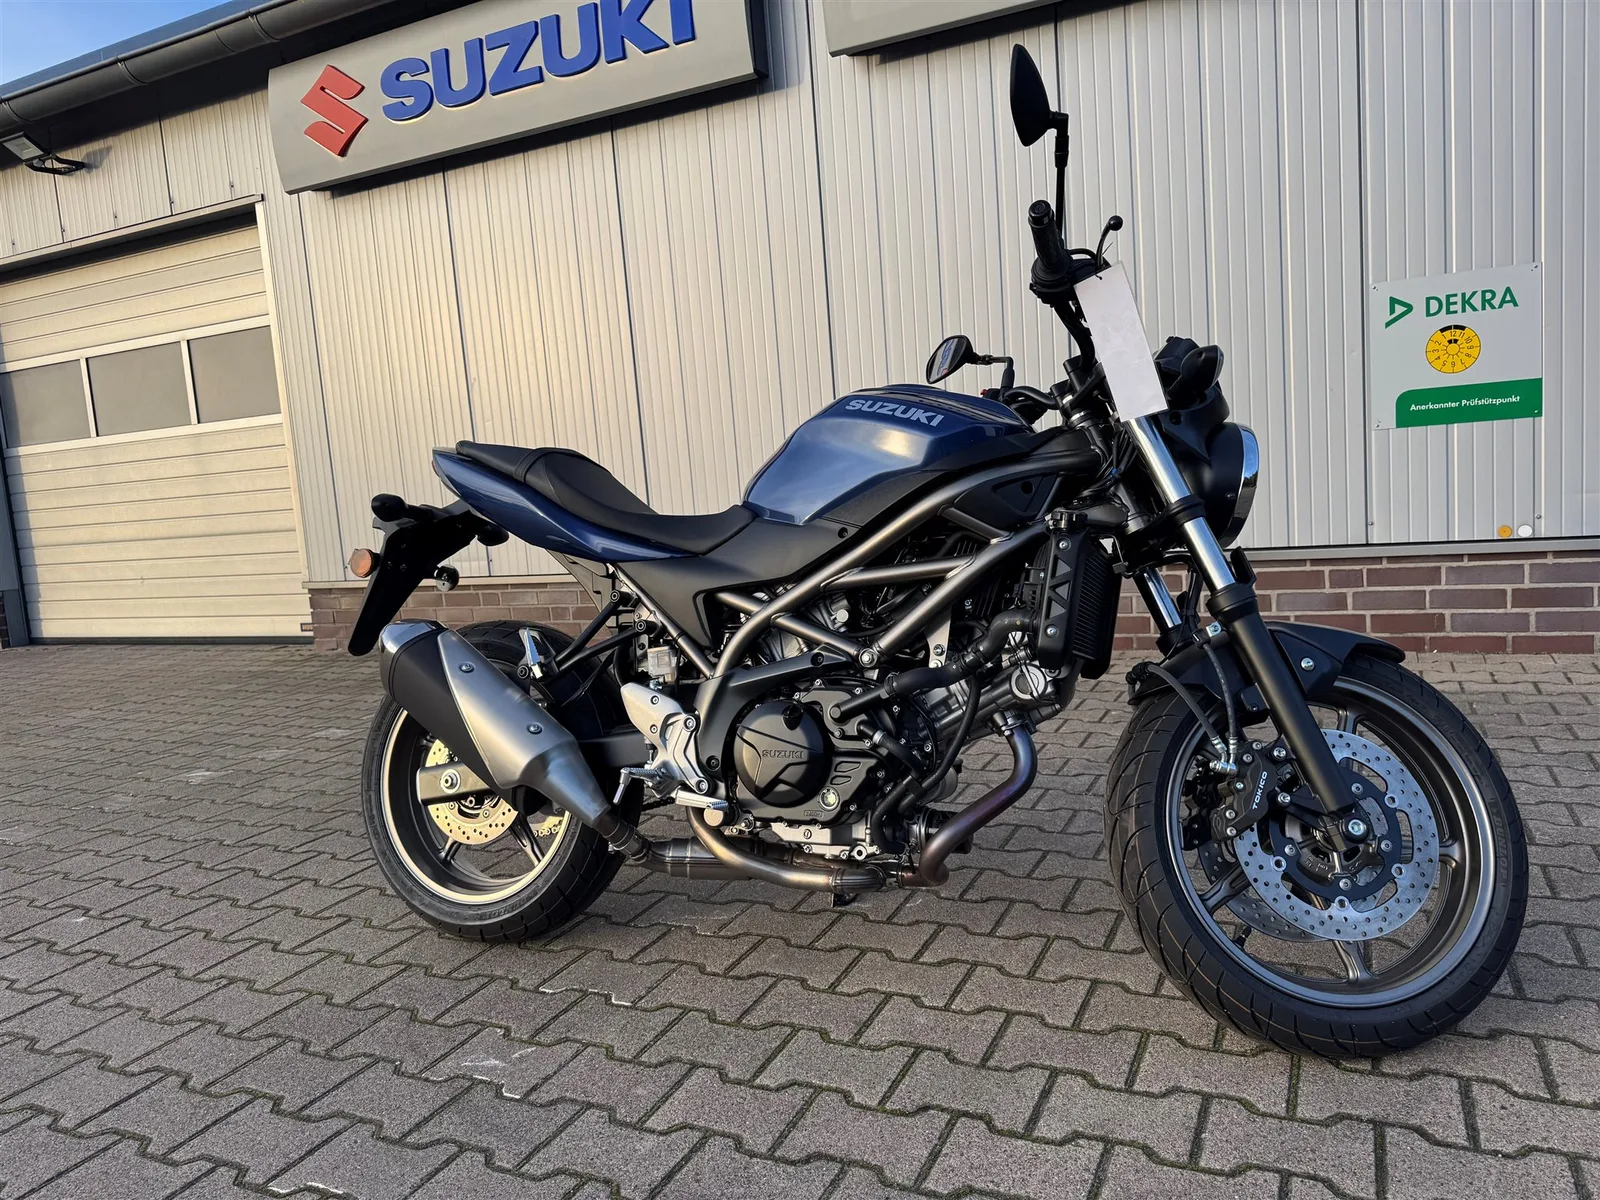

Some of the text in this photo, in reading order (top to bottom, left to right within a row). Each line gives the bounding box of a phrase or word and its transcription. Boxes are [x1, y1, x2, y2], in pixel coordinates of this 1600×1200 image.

[379, 0, 696, 122] SUZUKI
[1425, 286, 1519, 318] DEKRA
[845, 399, 945, 427] SUZUKI
[1410, 395, 1520, 412] Anerkannter Prüfstützpunkt
[762, 750, 804, 759] SUZUKI
[1252, 771, 1268, 810] TOKICO
[1493, 815, 1508, 880] DUNLOP
